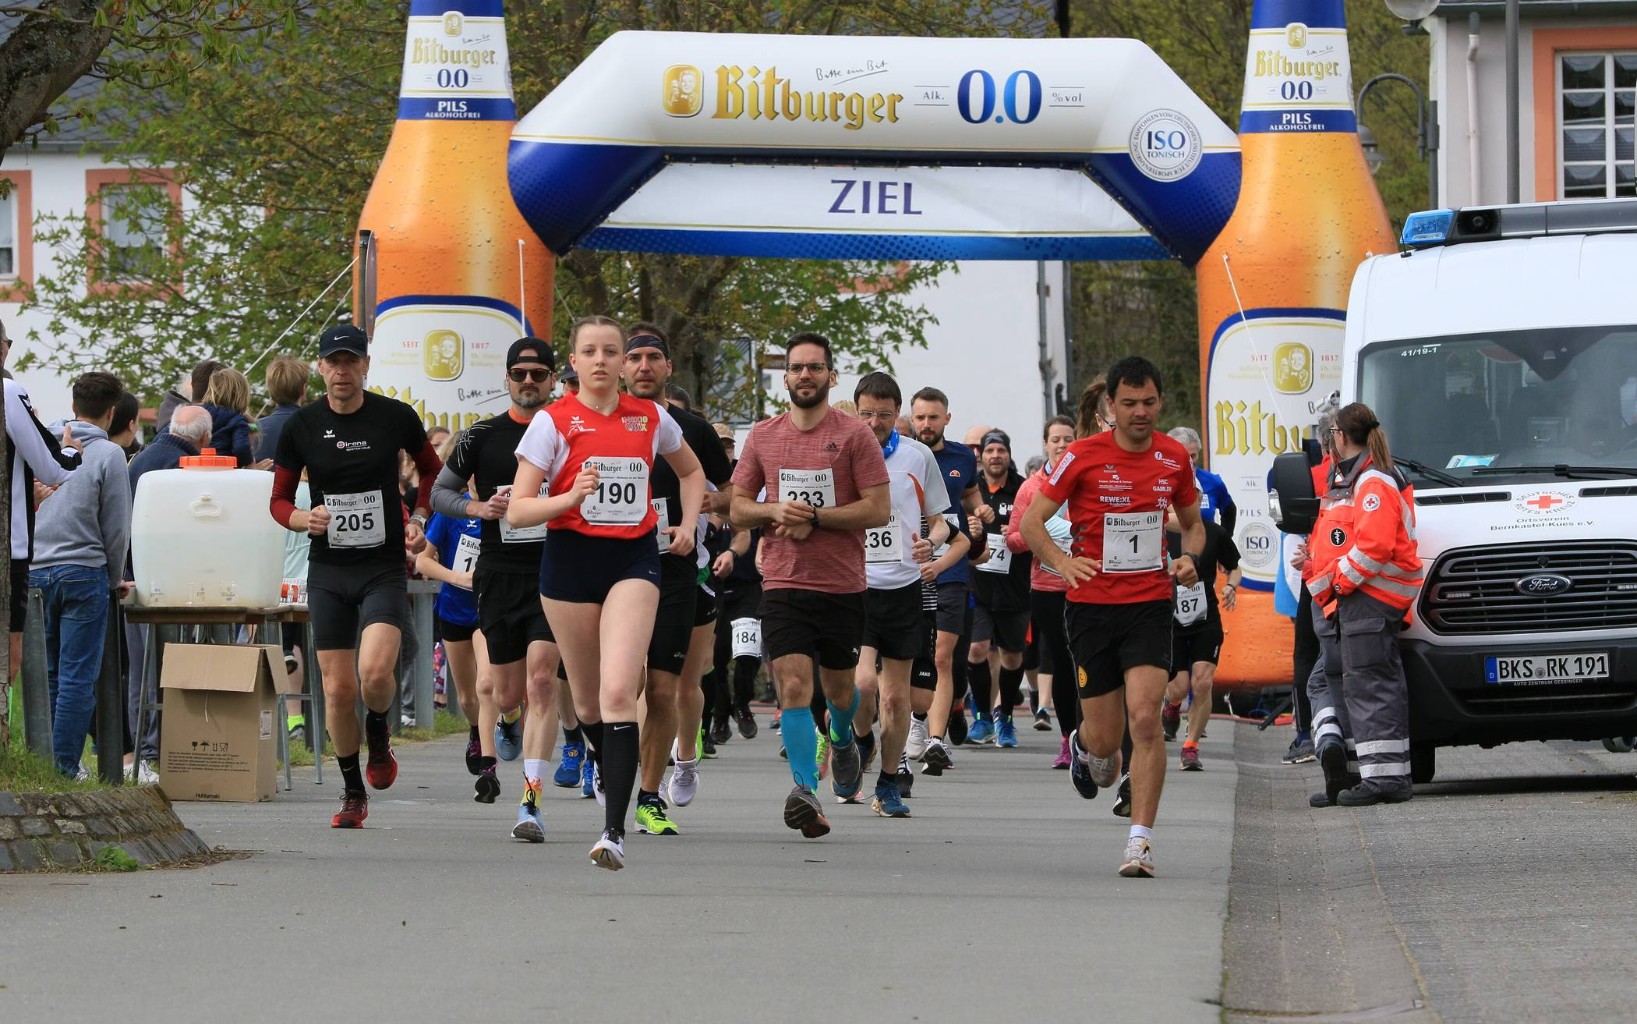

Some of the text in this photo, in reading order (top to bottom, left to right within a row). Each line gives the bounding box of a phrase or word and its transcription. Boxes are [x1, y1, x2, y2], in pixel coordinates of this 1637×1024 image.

[411, 37, 497, 69] Bitburger
[1254, 48, 1341, 80] Bitburger
[437, 69, 469, 88] 0.0
[711, 64, 904, 130] Bitburger
[922, 91, 945, 101] Alk.
[957, 69, 1043, 125] 0.0
[1280, 80, 1313, 101] 0.0
[424, 111, 481, 119] ALKOHOLFREI
[437, 101, 468, 112] PILS
[1282, 113, 1312, 124] PILS
[1147, 130, 1186, 150] ISO
[828, 179, 923, 215] ZIEL
[402, 341, 419, 349] SEIT
[597, 482, 637, 505] 190
[335, 513, 375, 532] 205
[1239, 509, 1262, 517] PILS
[1490, 520, 1575, 531] Bernkastel-Kues
[1128, 534, 1139, 554] 1
[1246, 536, 1270, 550] ISO
[1529, 578, 1558, 591] Ford
[735, 631, 757, 645] 184
[1498, 655, 1608, 679] BKS RK 191
